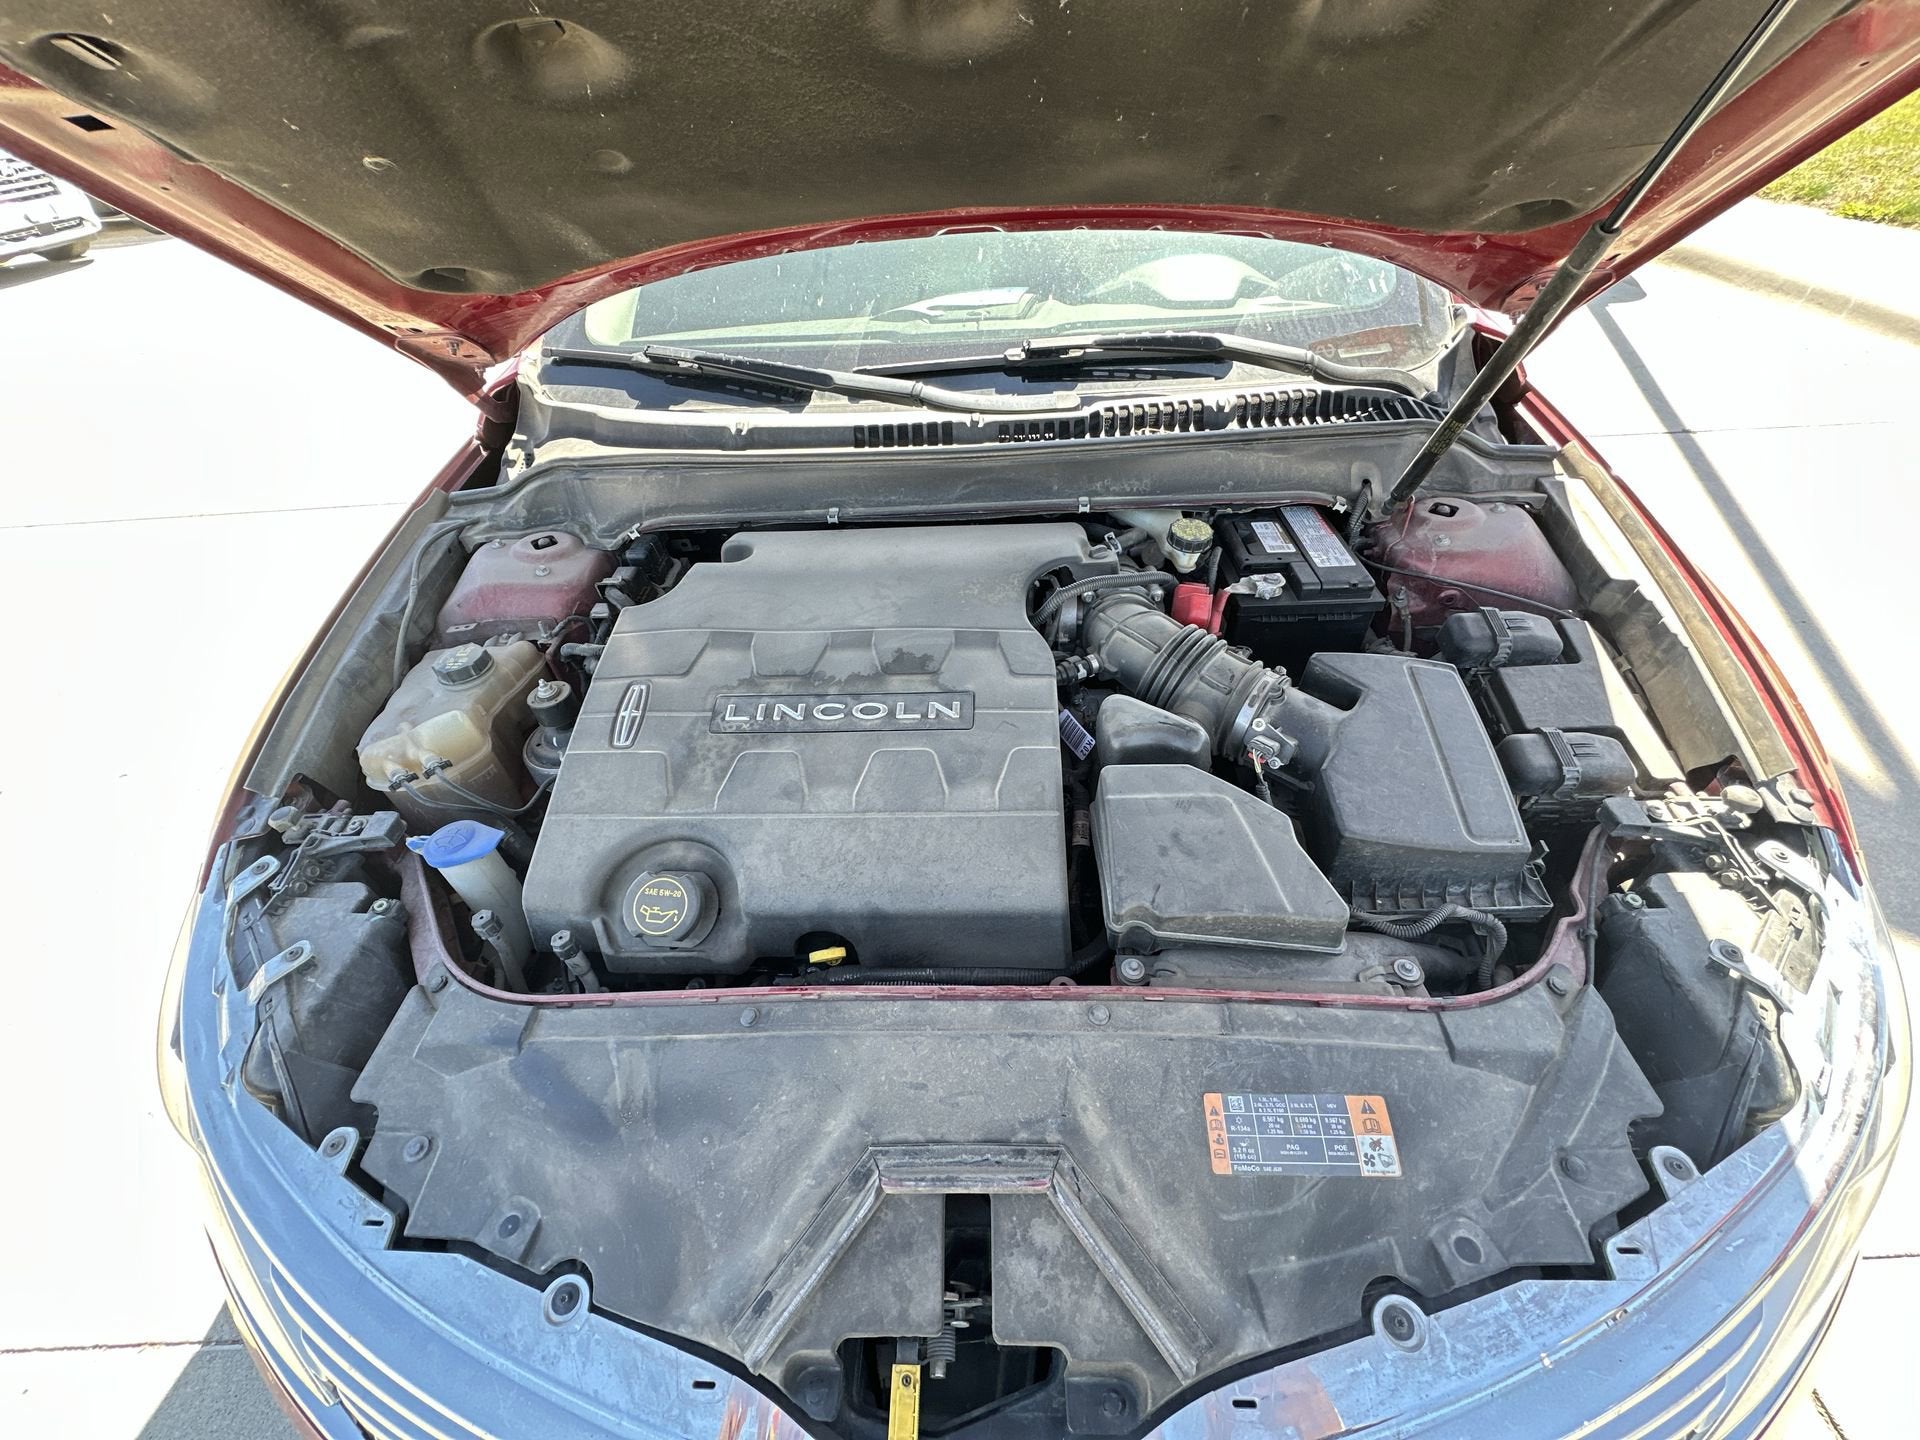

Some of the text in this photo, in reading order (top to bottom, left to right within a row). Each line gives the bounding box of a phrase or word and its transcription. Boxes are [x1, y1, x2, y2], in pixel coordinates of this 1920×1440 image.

[723, 700, 962, 722] LINCOLN
[644, 887, 682, 898] SAE 5W-20
